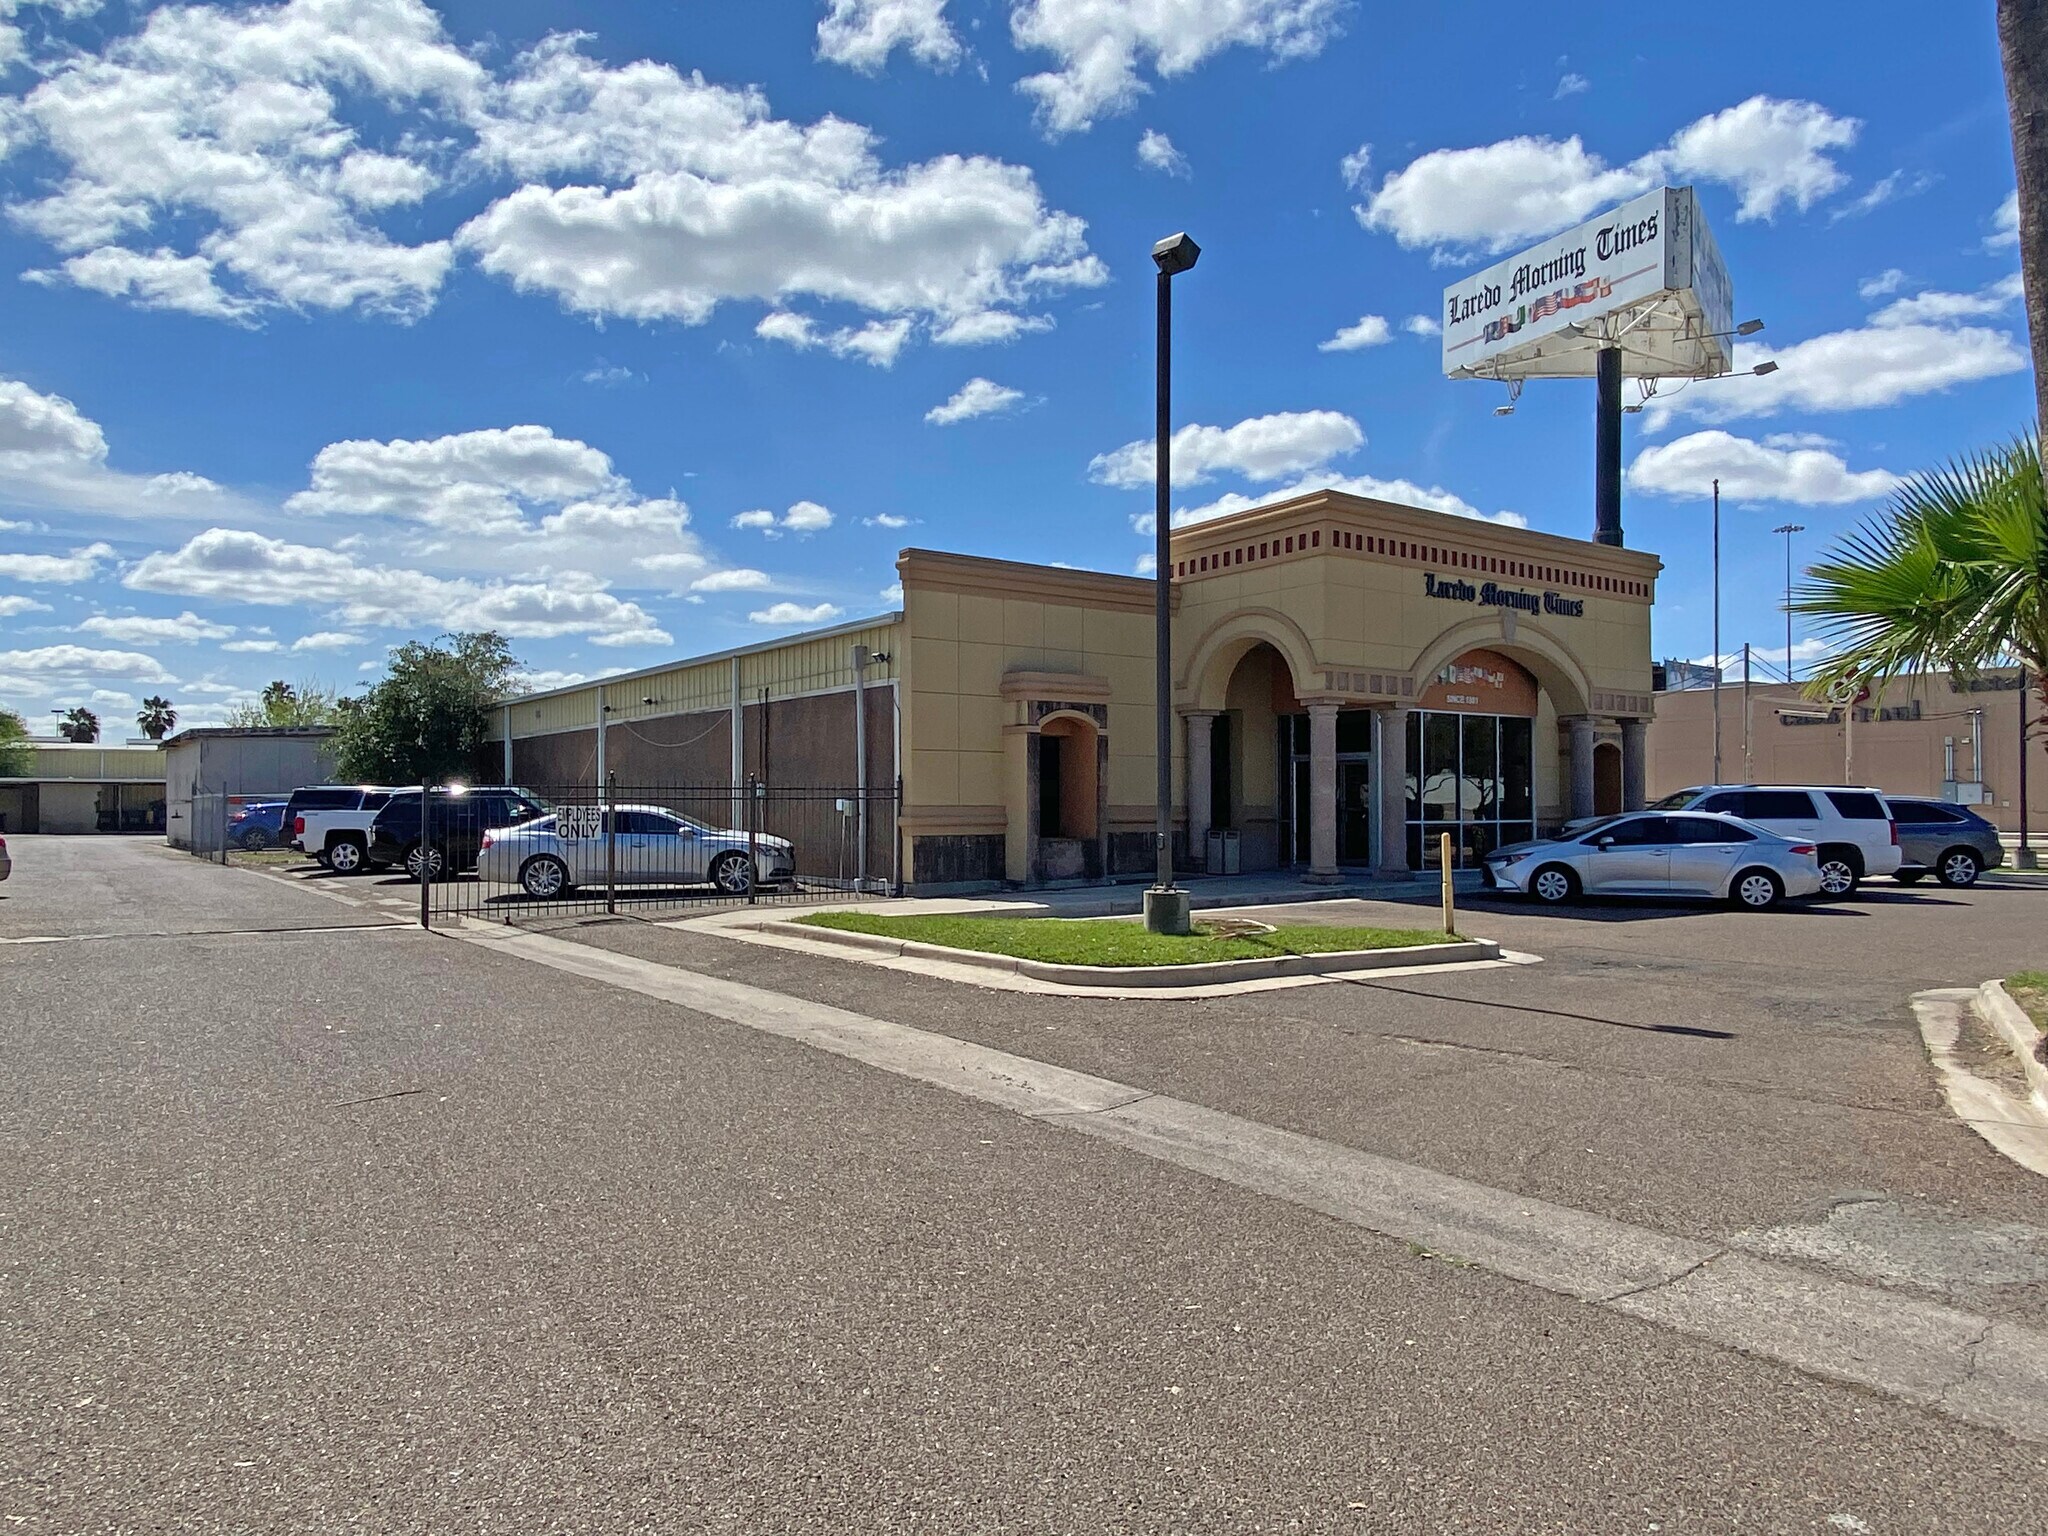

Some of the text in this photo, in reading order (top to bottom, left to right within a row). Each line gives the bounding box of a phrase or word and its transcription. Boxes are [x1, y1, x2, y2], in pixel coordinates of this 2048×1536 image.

[1449, 210, 1660, 327] Laredo Morning Times
[1424, 572, 1584, 617] Laredo Morning Times
[557, 807, 601, 839] EMPLOYEES ONLY
